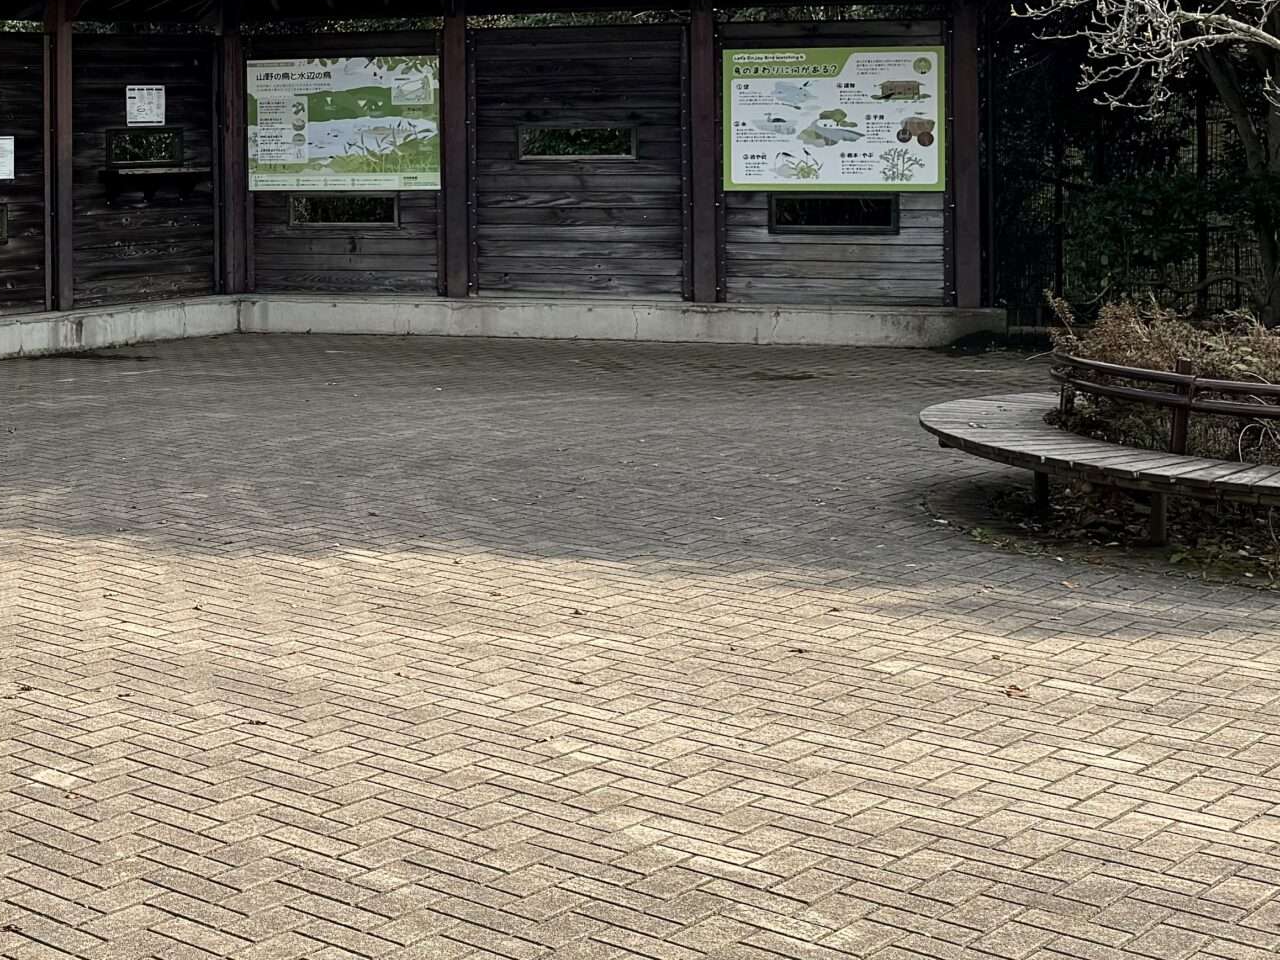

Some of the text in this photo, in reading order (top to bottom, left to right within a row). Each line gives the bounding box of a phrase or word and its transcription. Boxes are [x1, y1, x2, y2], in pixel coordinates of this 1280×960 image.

[256, 71, 332, 81] 山野の鳥と水辺の鳥
